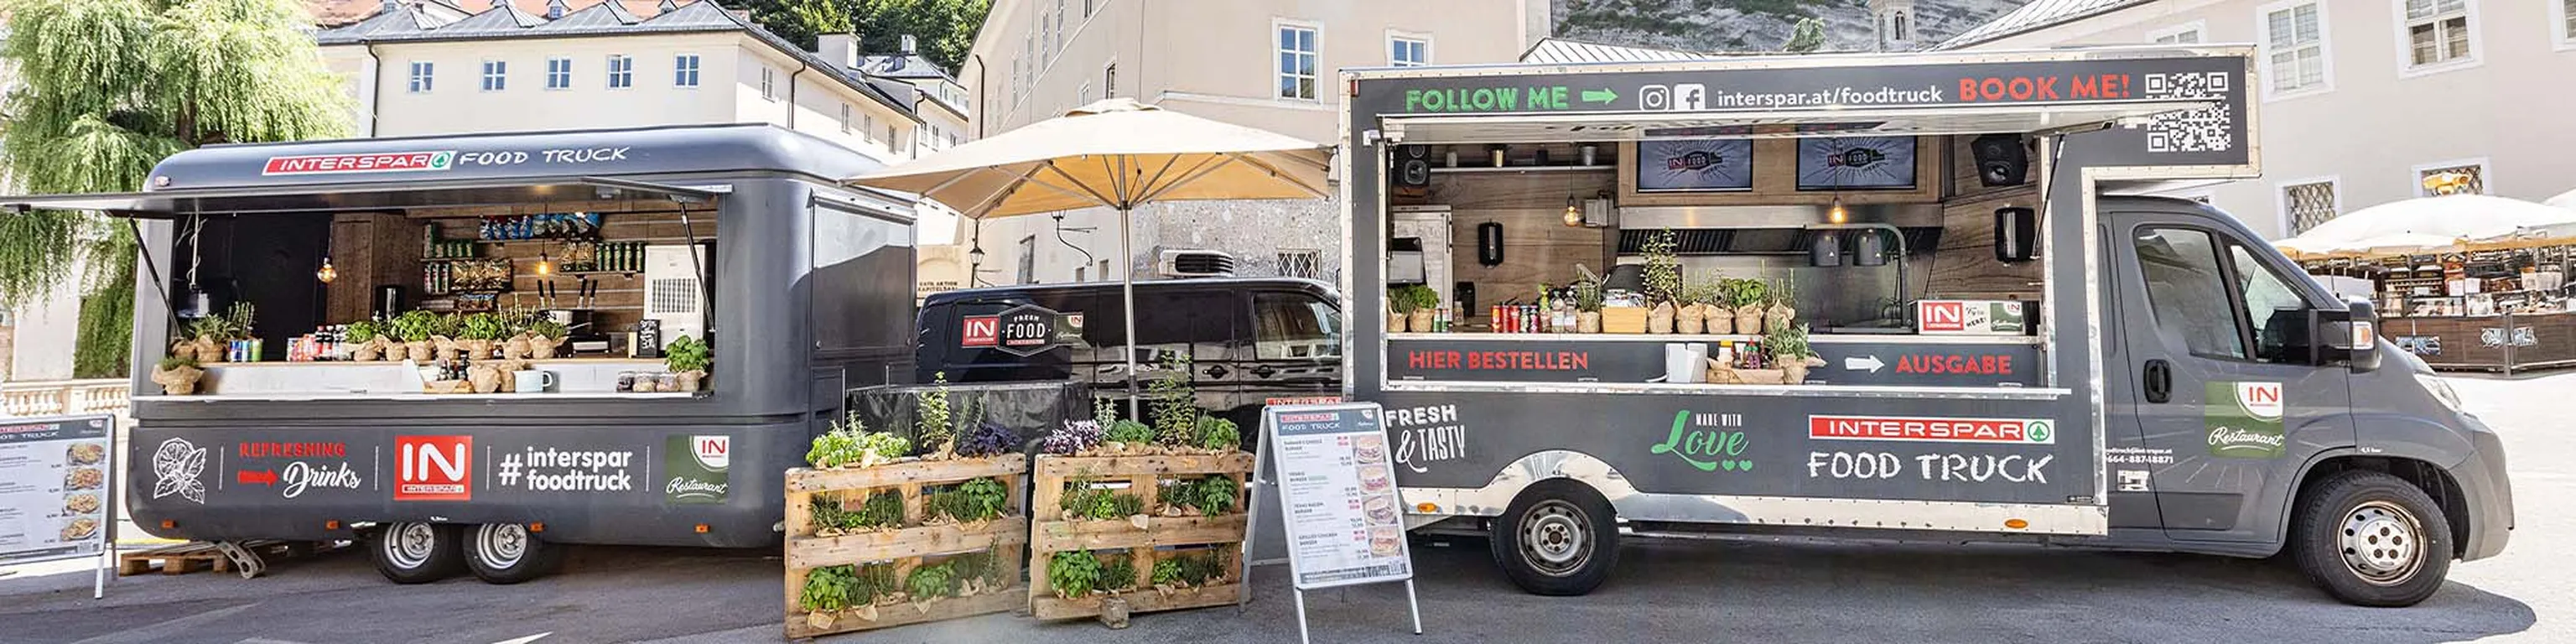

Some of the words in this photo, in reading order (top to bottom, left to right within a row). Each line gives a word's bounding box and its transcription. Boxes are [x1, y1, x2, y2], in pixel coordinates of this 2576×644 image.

[1717, 86, 1943, 108] interspar.at/foodtruck
[1959, 76, 2059, 101] BOOK
[2070, 74, 2131, 98] ME!
[1405, 87, 1519, 112] FOLLOW
[1528, 86, 1569, 109] ME
[279, 154, 429, 171] INTERSPAR
[460, 150, 529, 165] FOOD
[542, 146, 631, 164] TRUCK
[1925, 305, 1961, 323] IN
[966, 319, 995, 337] IN
[1006, 323, 1046, 339] FOOD
[1409, 351, 1461, 369] HIER
[1467, 351, 1589, 370] BESTELLEN
[1895, 355, 2012, 374] AUSGABE
[2248, 386, 2278, 402] IN
[1384, 404, 1457, 428] FRESH
[1829, 420, 2021, 439] INTERSPAR
[2208, 426, 2285, 447] Restaurant
[239, 442, 345, 457] REFRESHING
[701, 439, 726, 454] IN
[1395, 428, 1427, 474] &
[1417, 425, 1466, 461] TASTY
[1650, 409, 1750, 471] Love
[402, 443, 465, 482] IN
[1807, 451, 1902, 480] FOOD
[1915, 454, 2054, 484] TRUCK
[283, 461, 361, 498] Drinks
[527, 469, 631, 491] foodtruck
[666, 476, 729, 494] Restaurant
